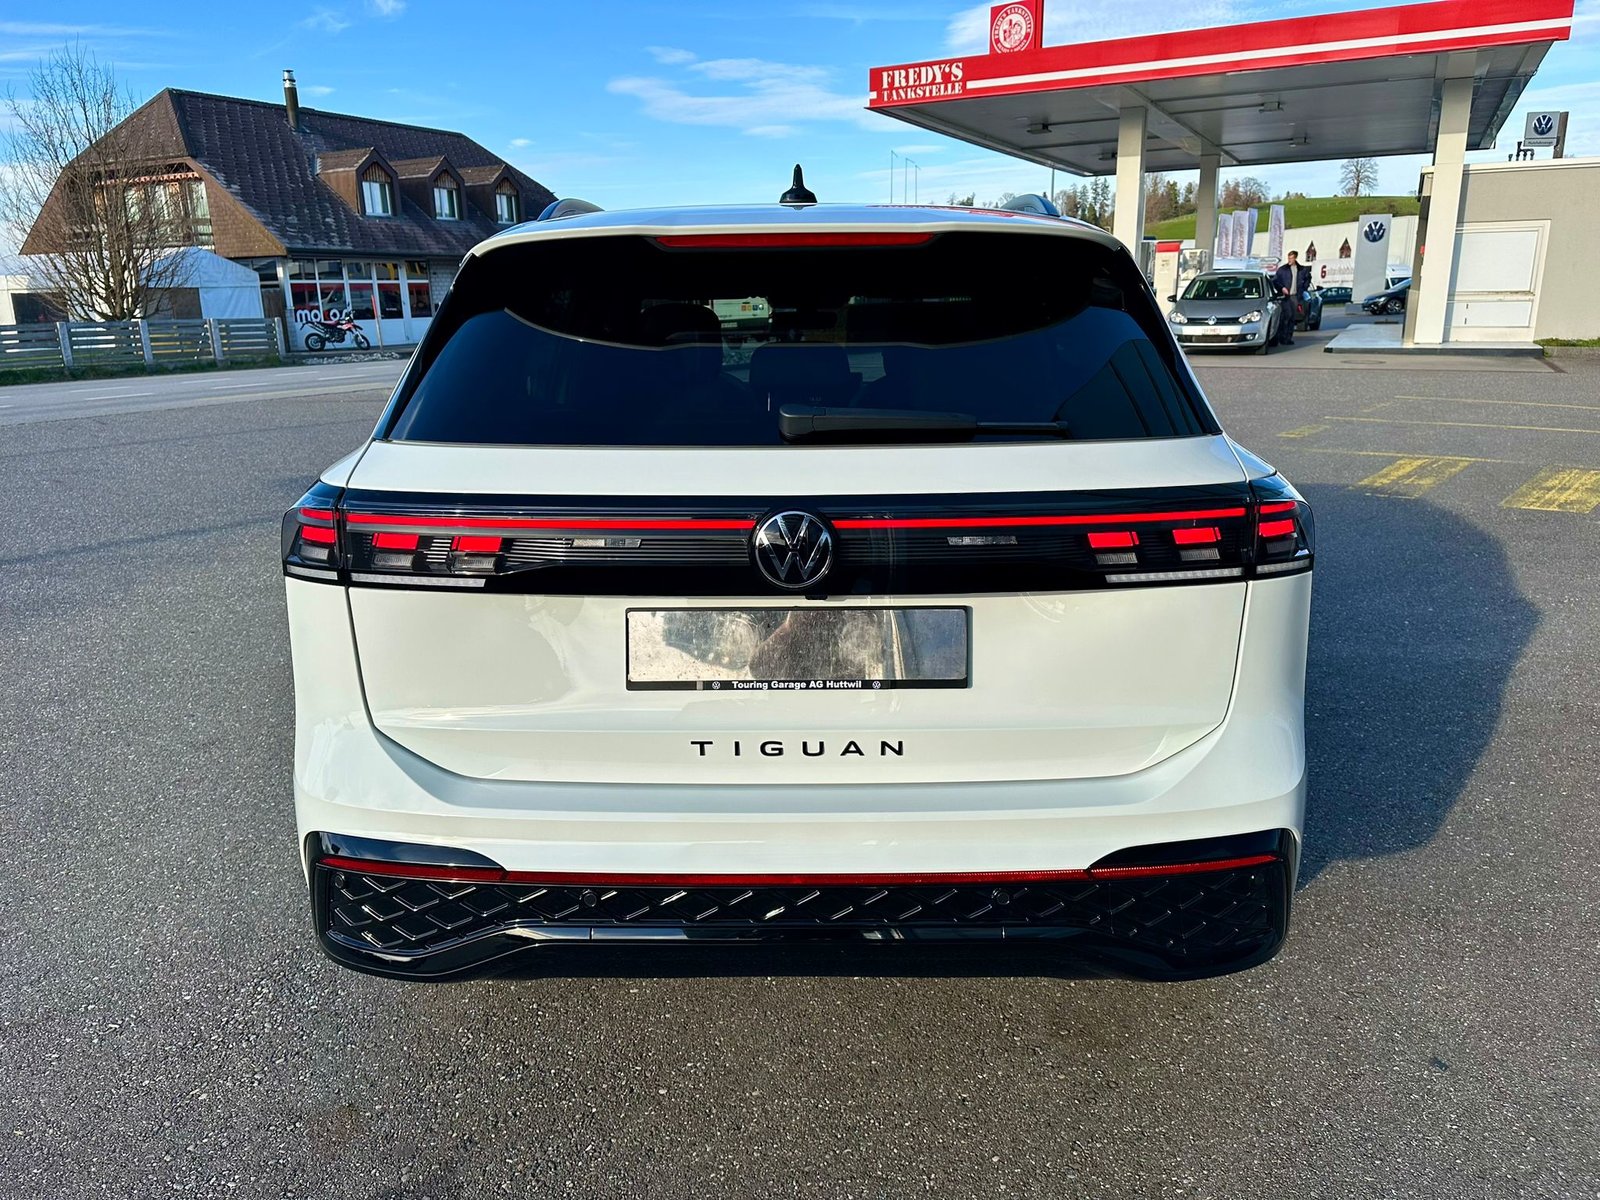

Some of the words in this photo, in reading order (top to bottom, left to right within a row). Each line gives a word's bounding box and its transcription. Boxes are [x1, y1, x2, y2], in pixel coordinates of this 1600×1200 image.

[882, 82, 963, 102] TANKSTELLE
[755, 510, 832, 588] VW
[732, 681, 768, 690] Touring
[771, 680, 807, 690] Garage
[809, 680, 824, 689] AG
[826, 680, 862, 689] Huttwil
[691, 740, 904, 757] TIGUAN
